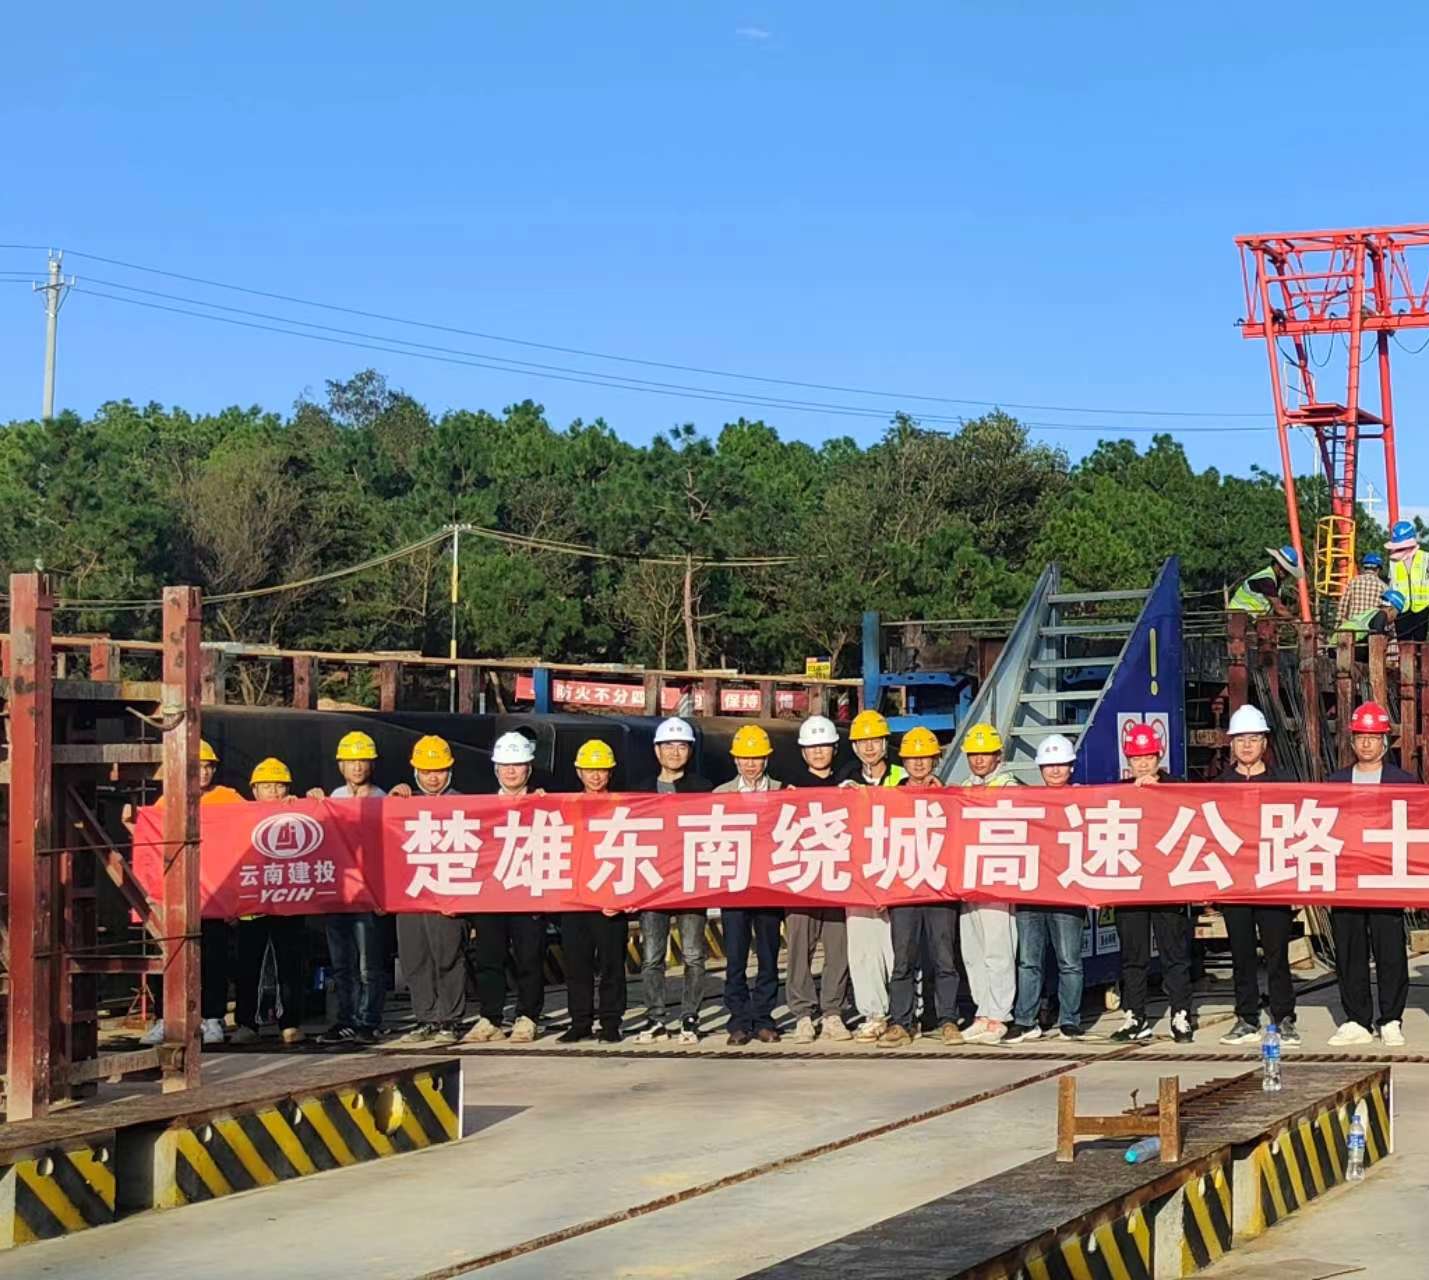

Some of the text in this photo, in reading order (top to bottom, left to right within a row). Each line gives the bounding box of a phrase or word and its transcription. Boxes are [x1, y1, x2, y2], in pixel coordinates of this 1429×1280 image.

[239, 860, 336, 887] 云南建投
[260, 887, 315, 903] YCIH
